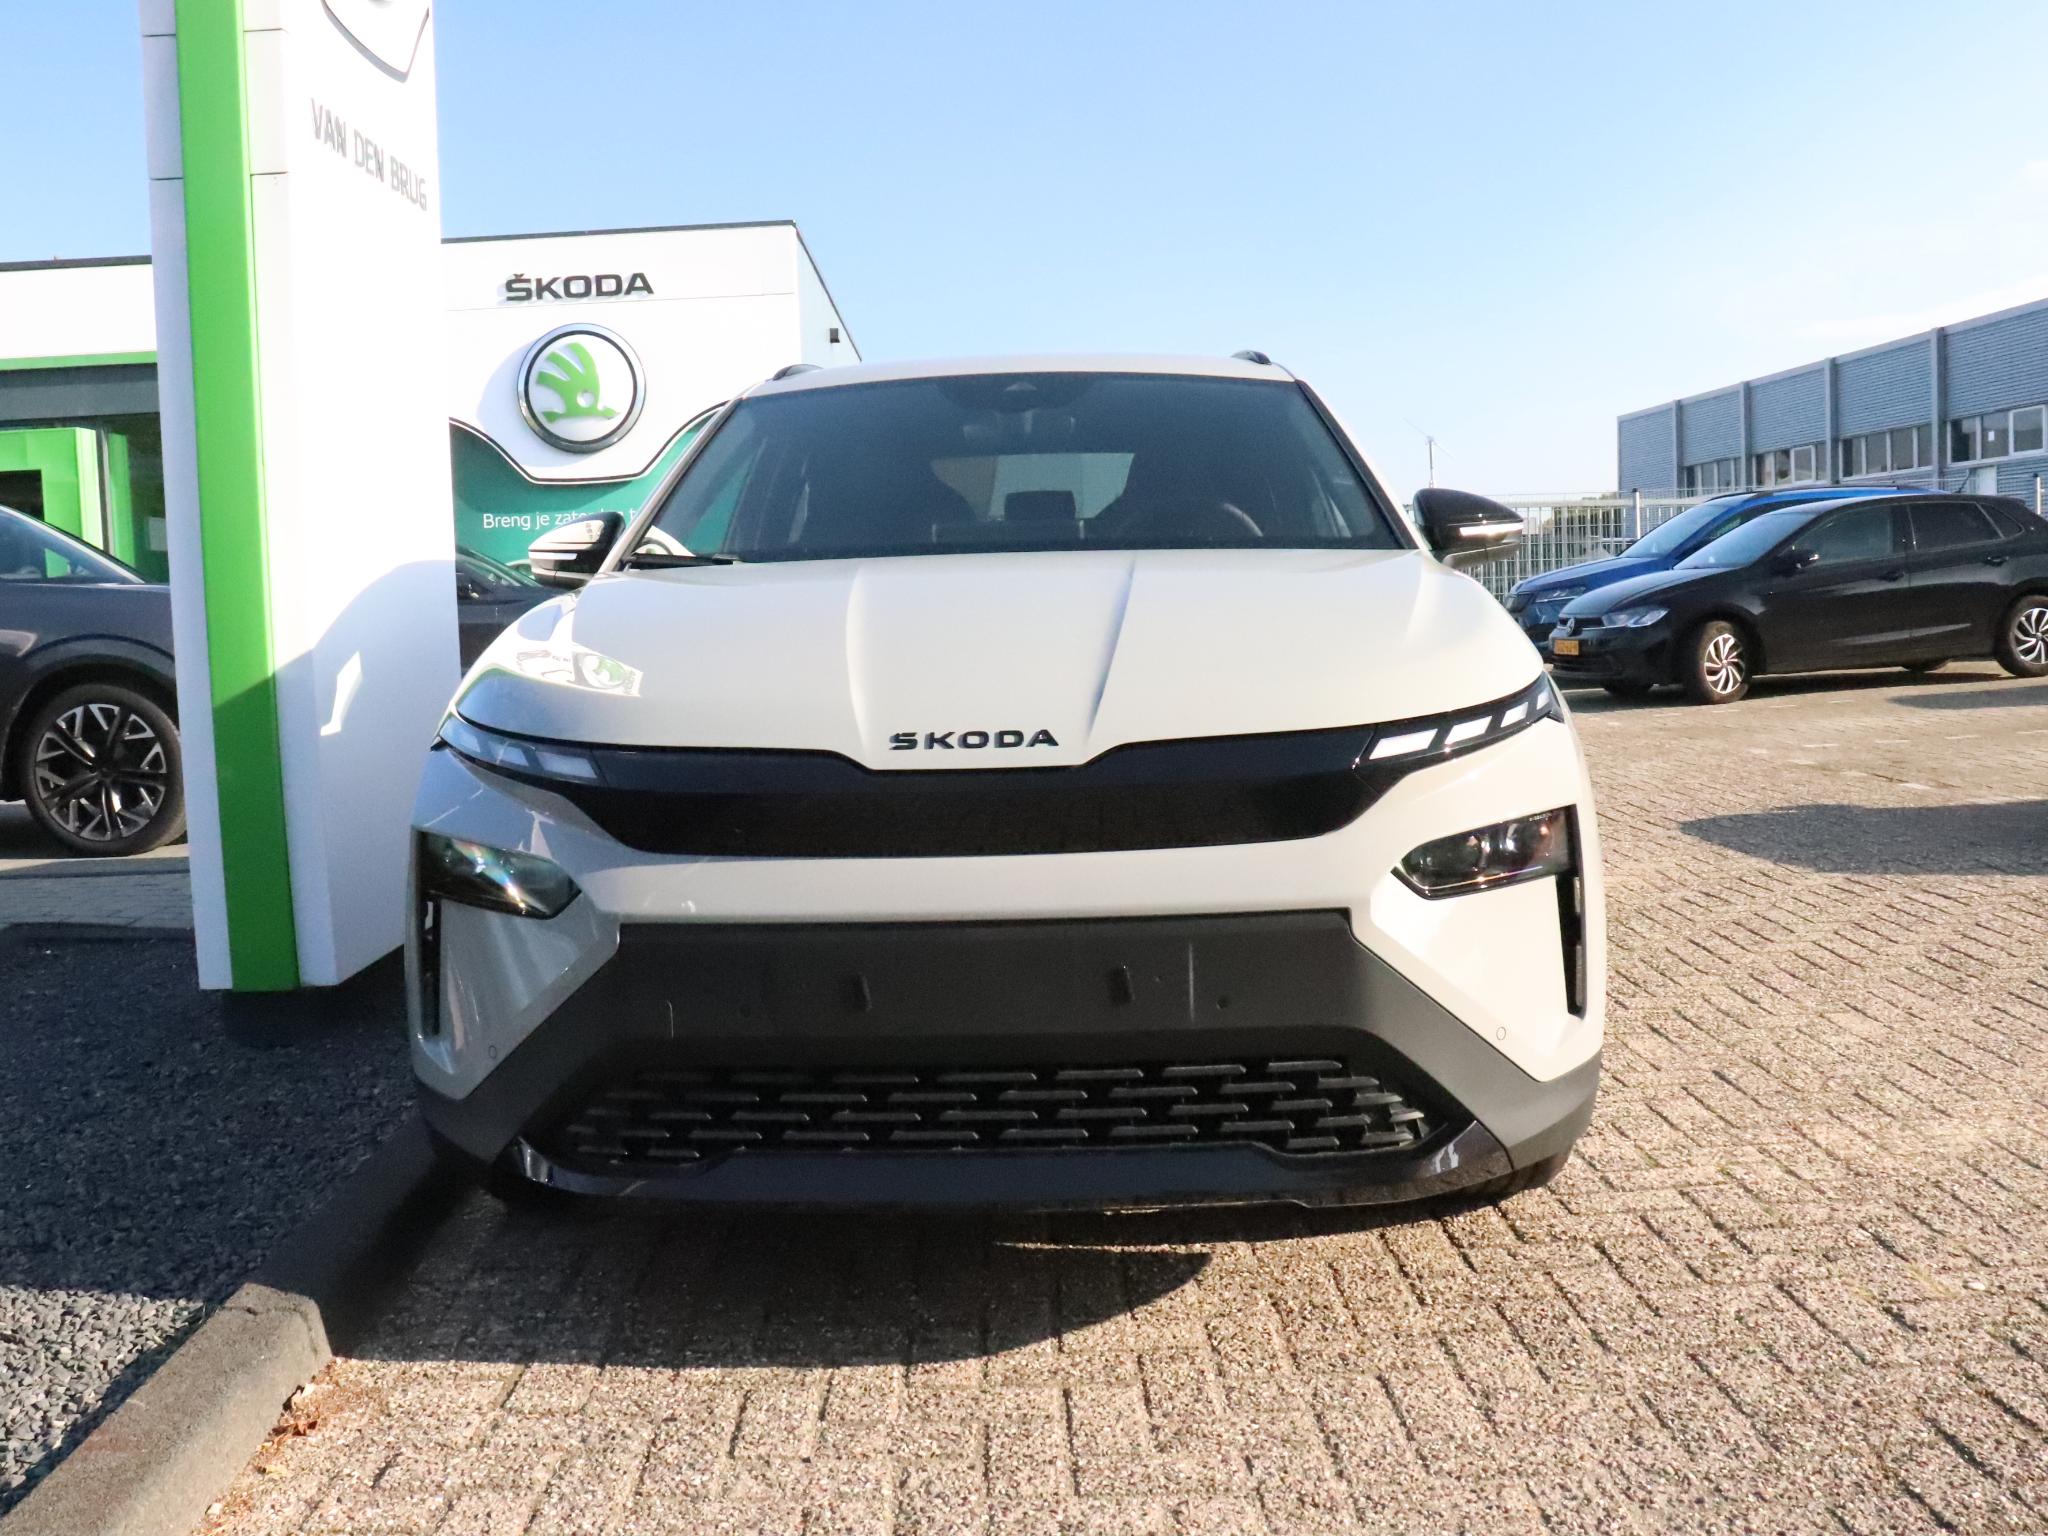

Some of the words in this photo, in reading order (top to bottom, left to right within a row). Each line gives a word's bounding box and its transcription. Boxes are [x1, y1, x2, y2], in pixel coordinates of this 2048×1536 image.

[311, 98, 347, 158] VAN
[354, 129, 384, 183] DEN
[390, 155, 427, 212] BRUG
[505, 273, 655, 302] ŠKODA
[483, 512, 531, 530] Breng
[535, 511, 550, 529] je
